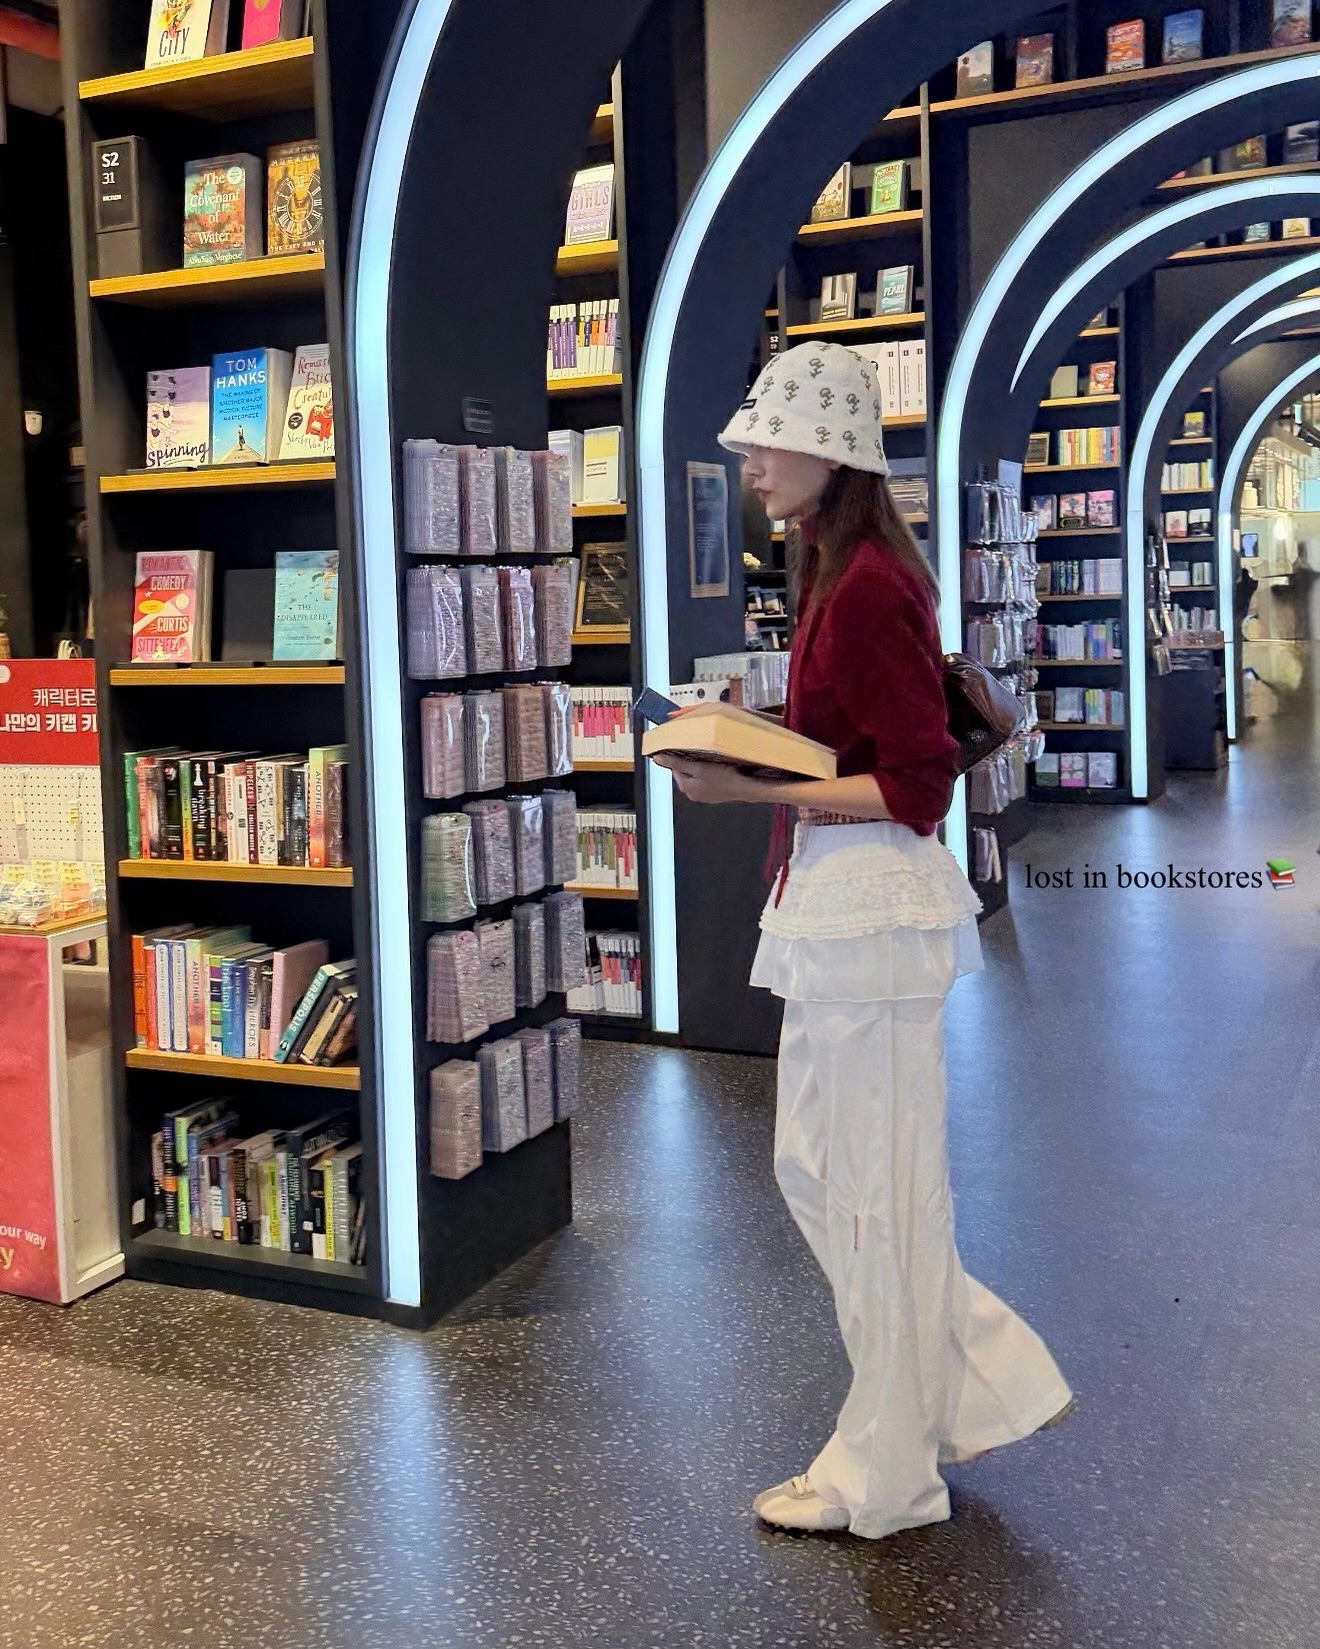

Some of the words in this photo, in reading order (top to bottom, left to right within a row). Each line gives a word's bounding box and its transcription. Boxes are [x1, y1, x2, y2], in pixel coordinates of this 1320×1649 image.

[159, 27, 190, 58] CITY
[101, 151, 120, 168] S2
[101, 171, 116, 185] 31
[203, 172, 226, 185] The
[190, 189, 241, 207] Covenant
[208, 210, 221, 224] of
[198, 231, 231, 245] Water
[225, 357, 257, 373] TOM
[216, 370, 266, 389] HANKS
[147, 442, 209, 467] Spinning
[151, 575, 188, 591] COMEDY
[156, 616, 189, 632] CURTIS
[281, 613, 328, 621] DISAPPEARED
[32, 688, 97, 707] 캐릭터로
[45, 713, 77, 732] 키캡
[246, 763, 255, 801] HOPELESS
[191, 797, 199, 822] dawn
[197, 789, 208, 829] breaking
[192, 961, 200, 1005] ANOTHER
[247, 966, 258, 995] Stephen
[288, 972, 325, 1032] PERSEPOLIS
[0, 1225, 22, 1239] our
[24, 1229, 47, 1250] way
